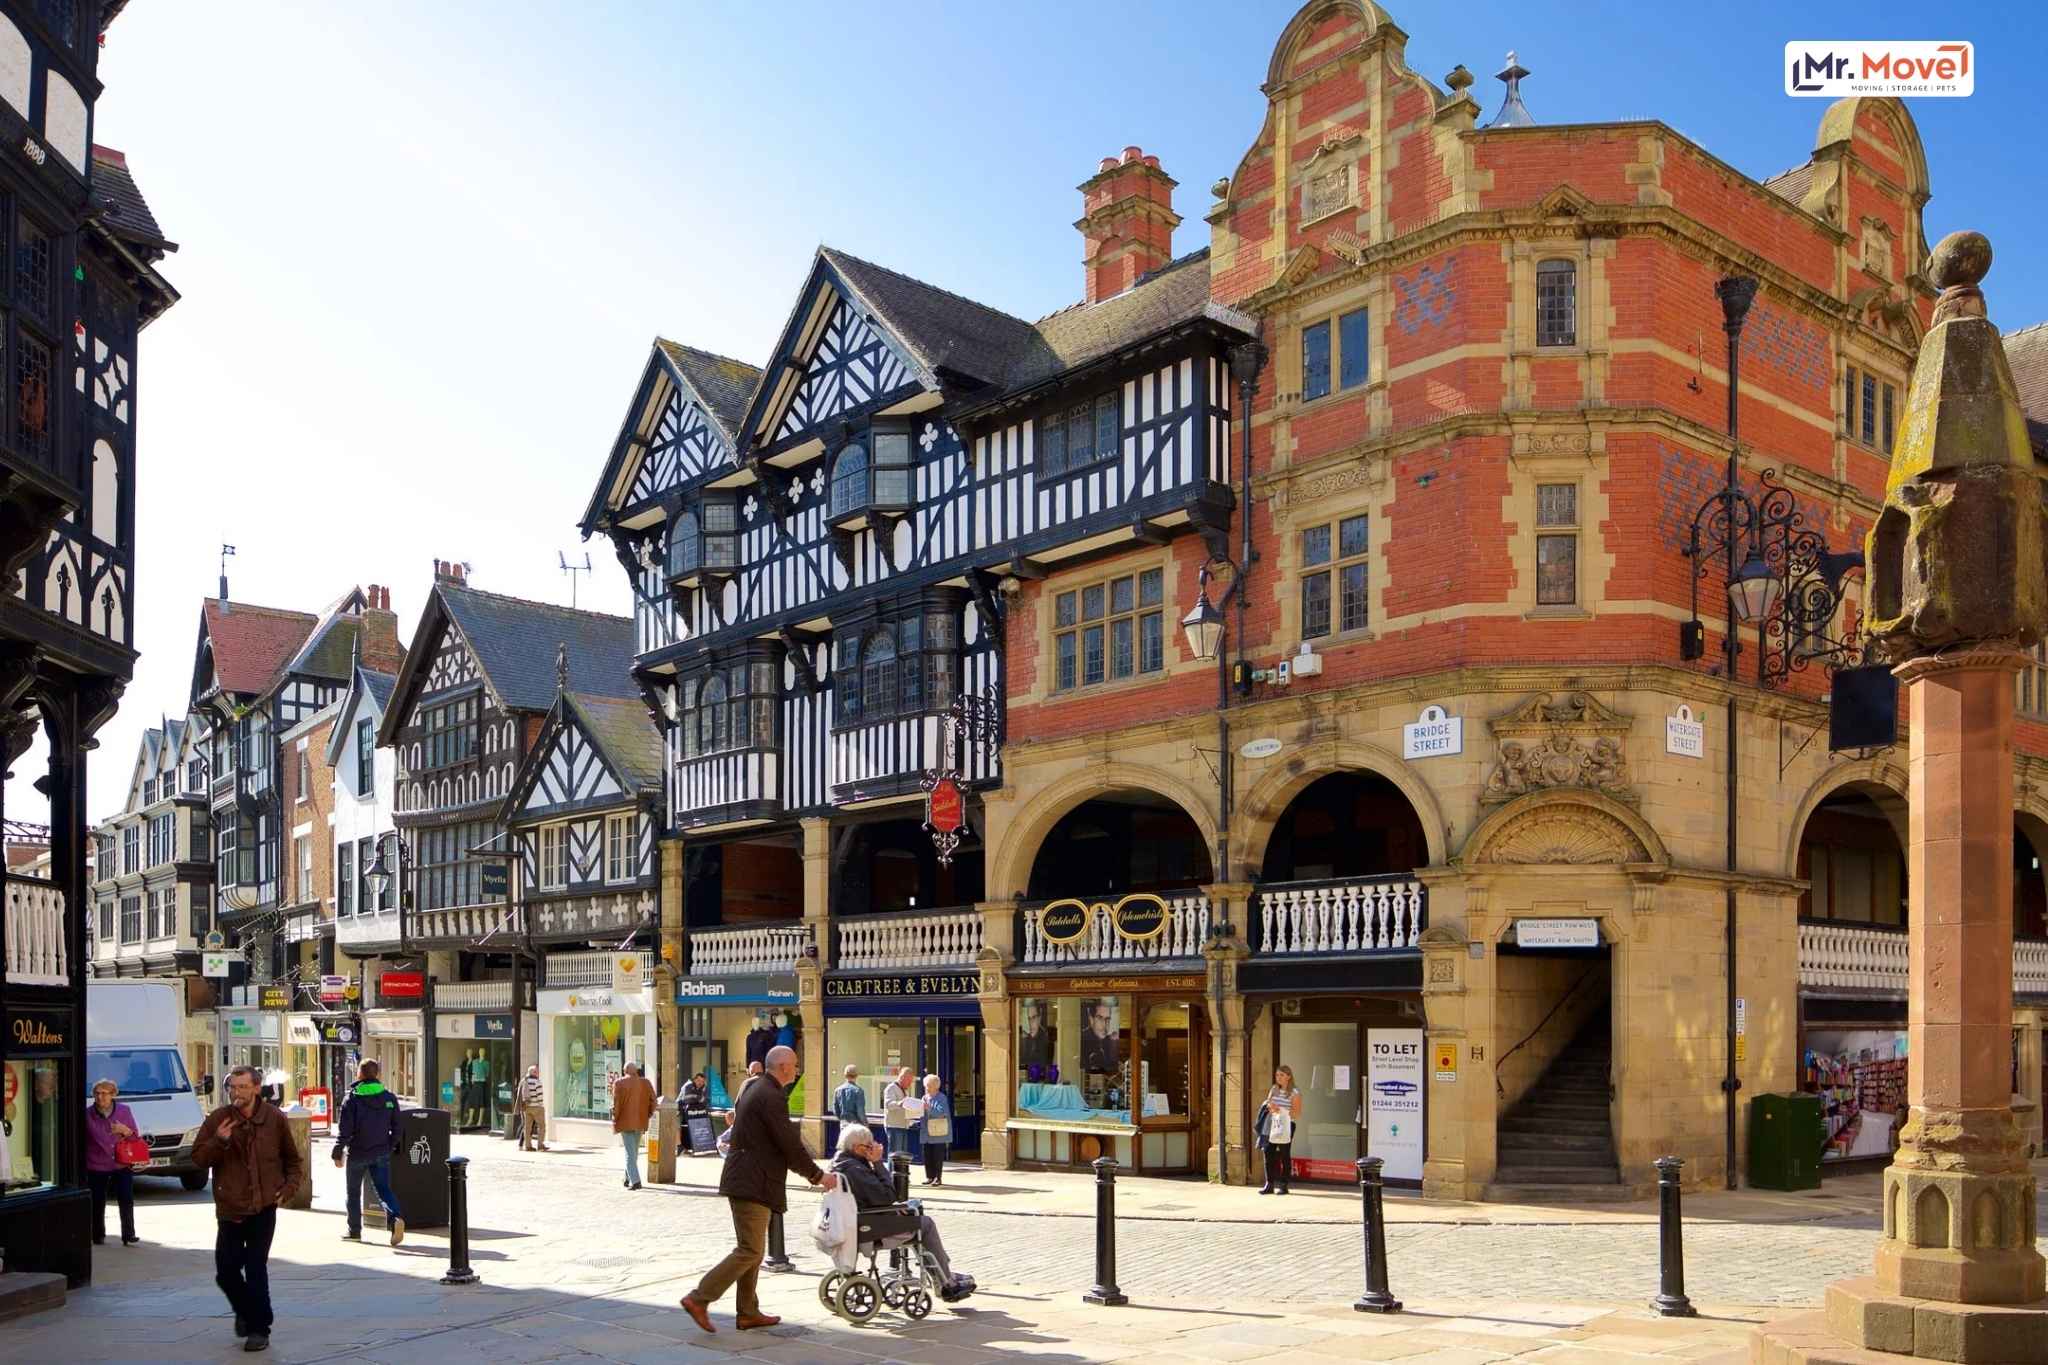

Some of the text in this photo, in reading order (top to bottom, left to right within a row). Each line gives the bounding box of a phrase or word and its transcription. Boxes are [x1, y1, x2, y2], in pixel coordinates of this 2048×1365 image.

[24, 137, 46, 165] 1888
[1414, 723, 1450, 738] BRIDGE
[1669, 721, 1701, 738] WATERGATE
[1413, 737, 1450, 752] STREET
[1673, 736, 1697, 750] STREET
[681, 981, 725, 996] Rohan
[827, 976, 981, 995] CRABTREE & EVELYN
[265, 989, 284, 998] CITY
[768, 990, 794, 998] Rohan
[263, 998, 288, 1007] NEWS
[13, 1019, 63, 1045] Waltons
[1373, 1044, 1418, 1054] TO LET
